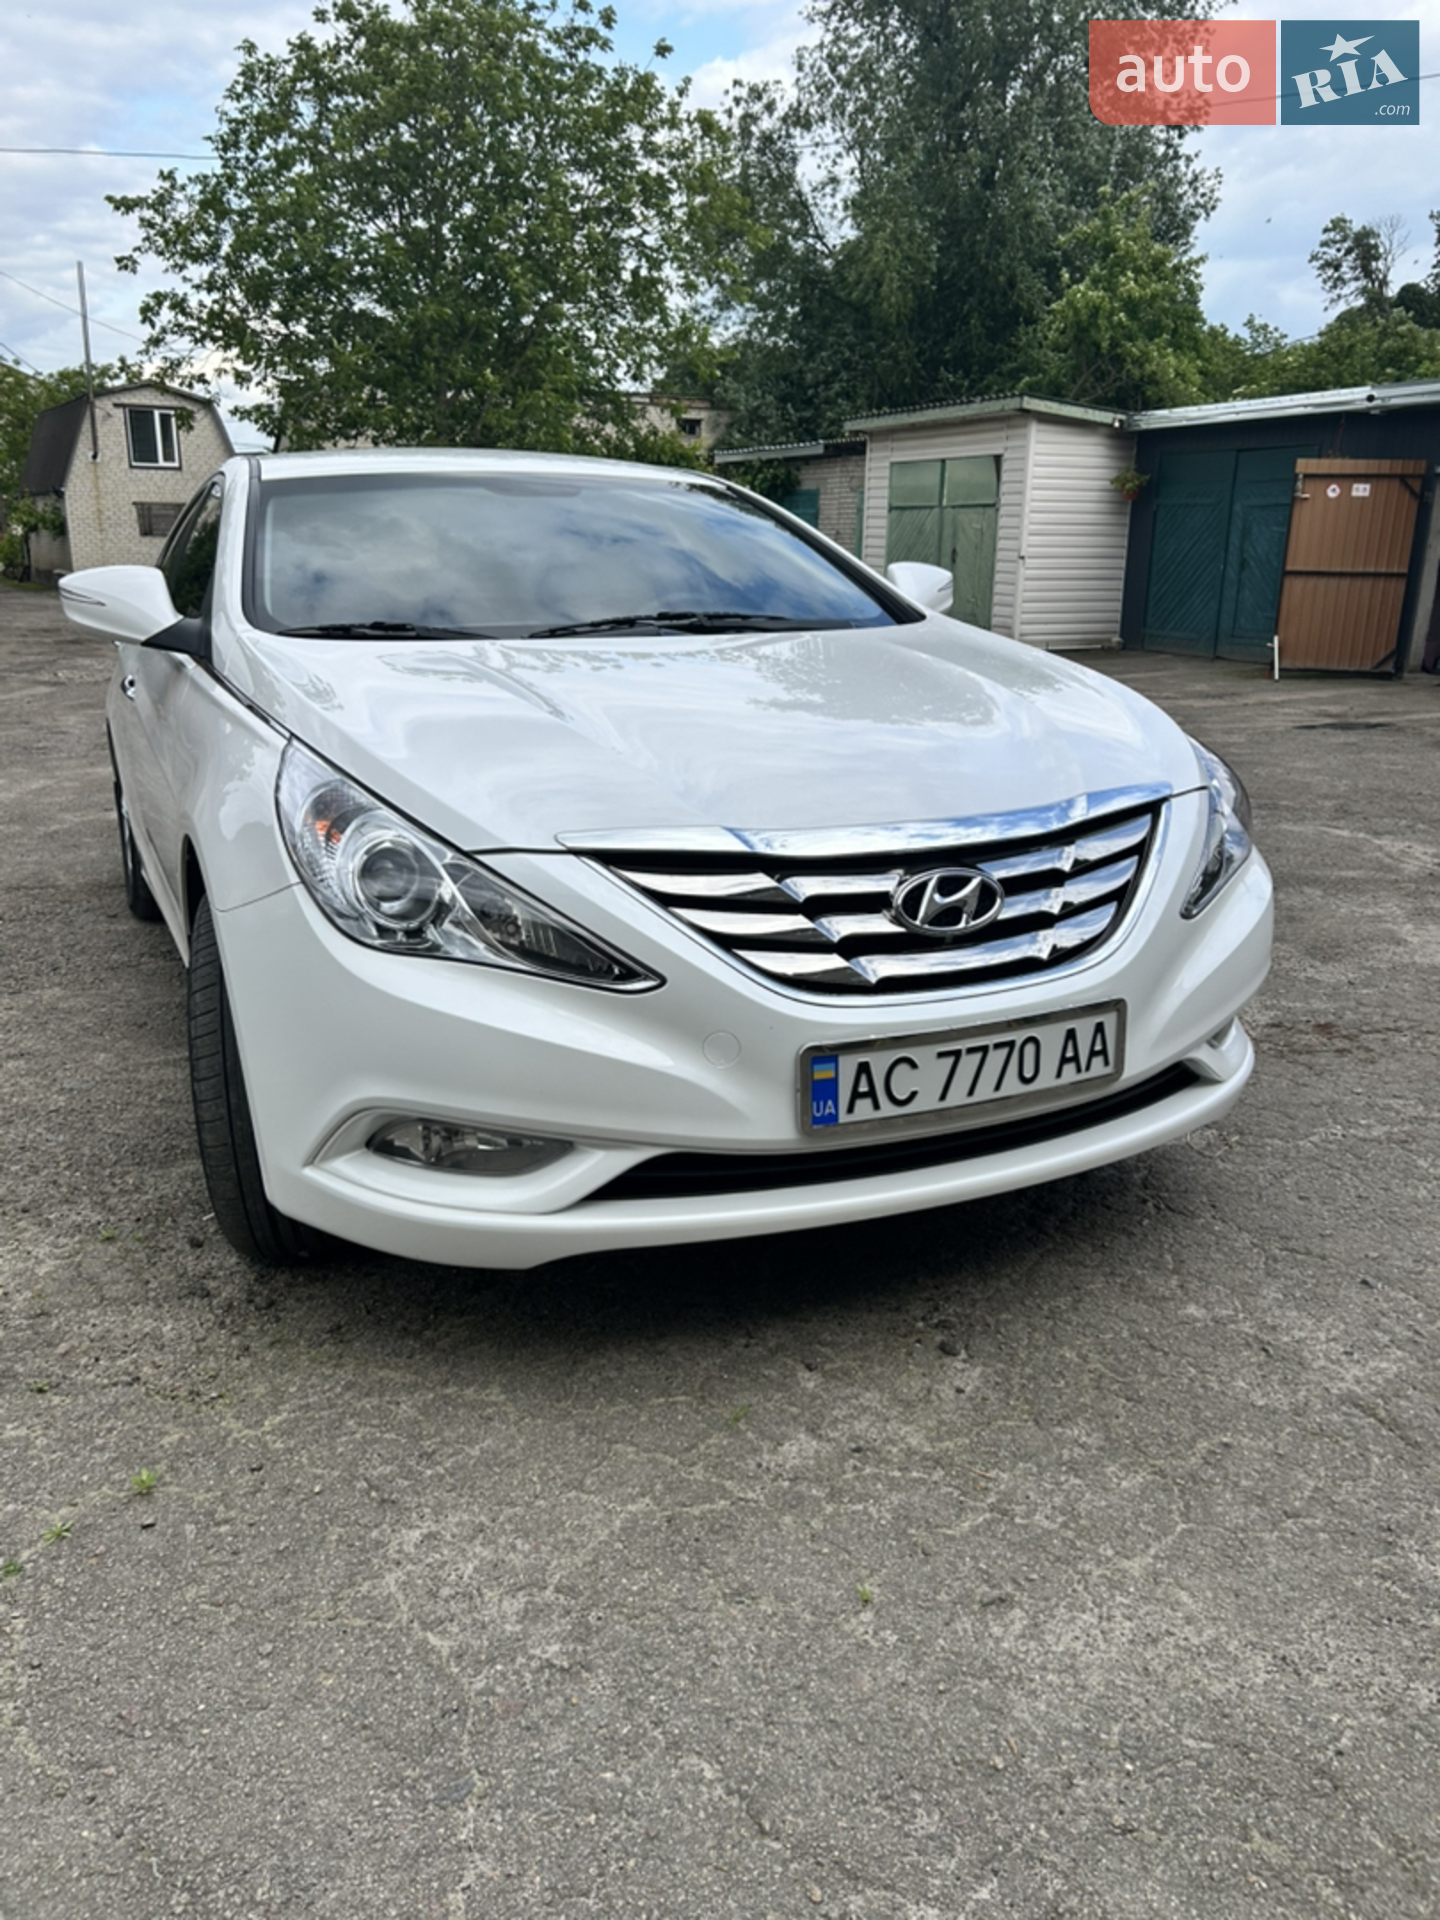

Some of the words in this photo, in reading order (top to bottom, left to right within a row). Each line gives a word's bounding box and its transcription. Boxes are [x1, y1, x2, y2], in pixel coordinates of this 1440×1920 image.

[846, 1055, 920, 1115] AC
[936, 1035, 1042, 1102] 7770
[1054, 1020, 1111, 1080] AA
[812, 1099, 836, 1118] UA
